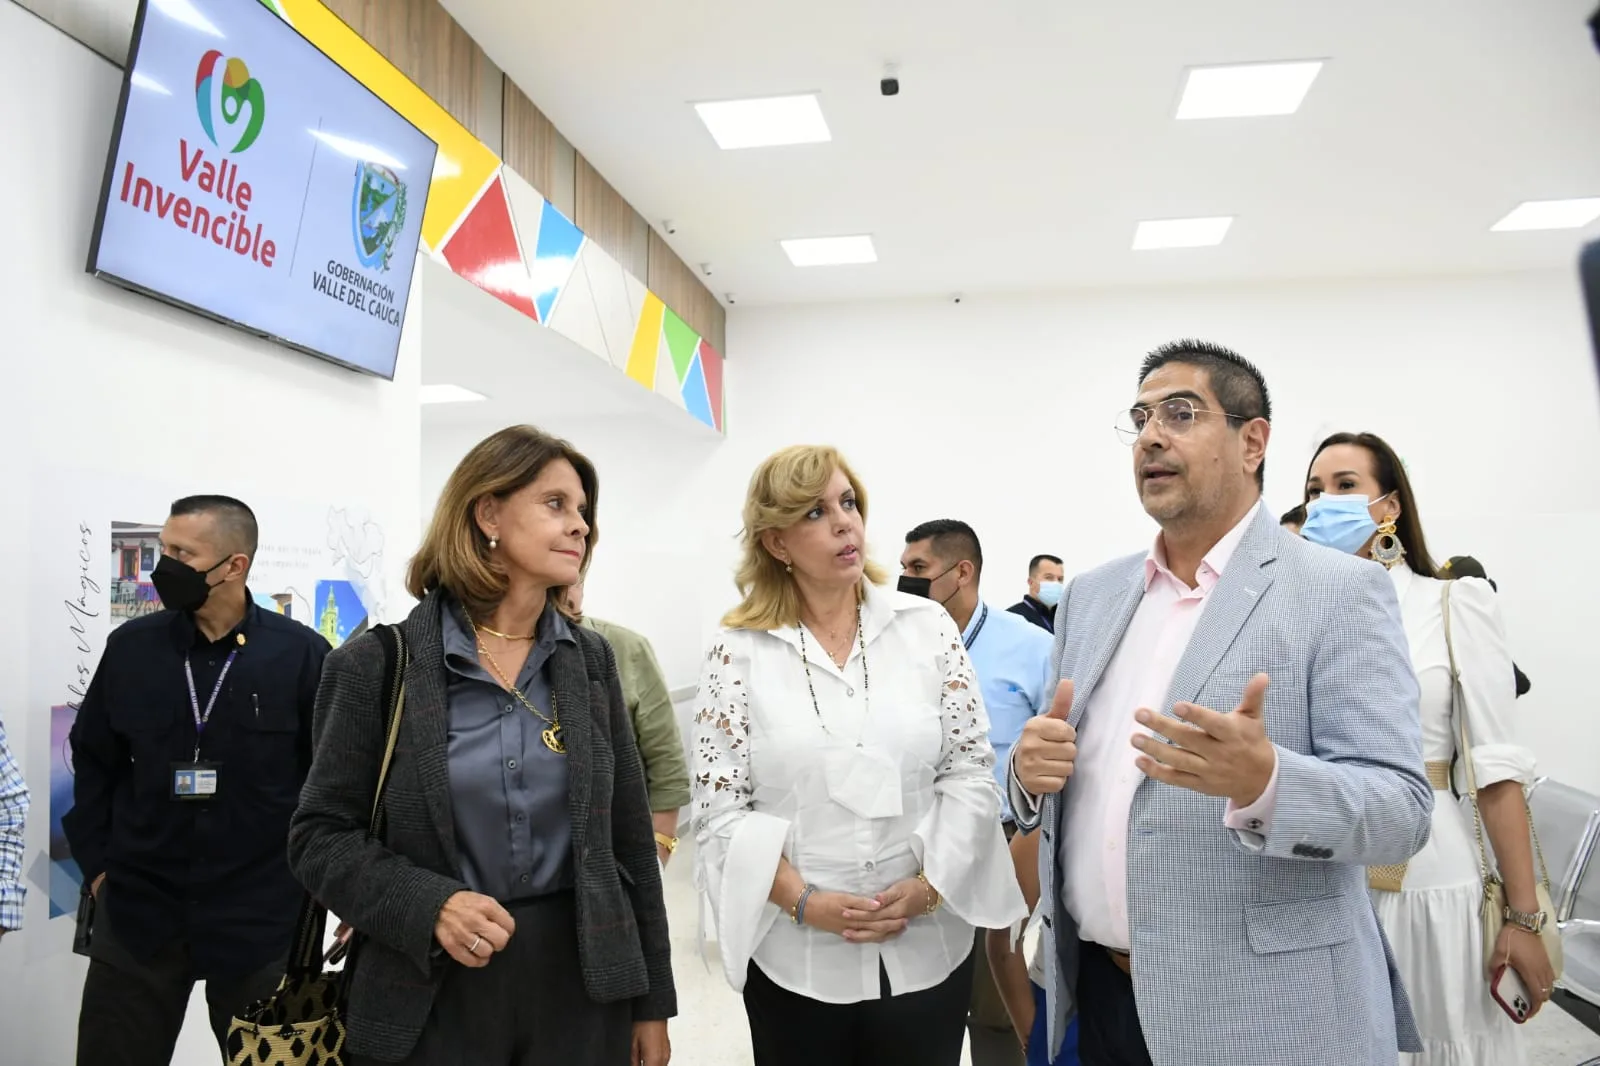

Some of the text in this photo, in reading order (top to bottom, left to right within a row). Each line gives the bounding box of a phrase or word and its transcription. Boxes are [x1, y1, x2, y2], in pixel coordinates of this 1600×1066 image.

[180, 138, 252, 212] Valle
[120, 161, 276, 268] Invencible
[313, 271, 400, 327] VALLE DEL CAUCA
[327, 259, 395, 303] GOBERNACIÓN
